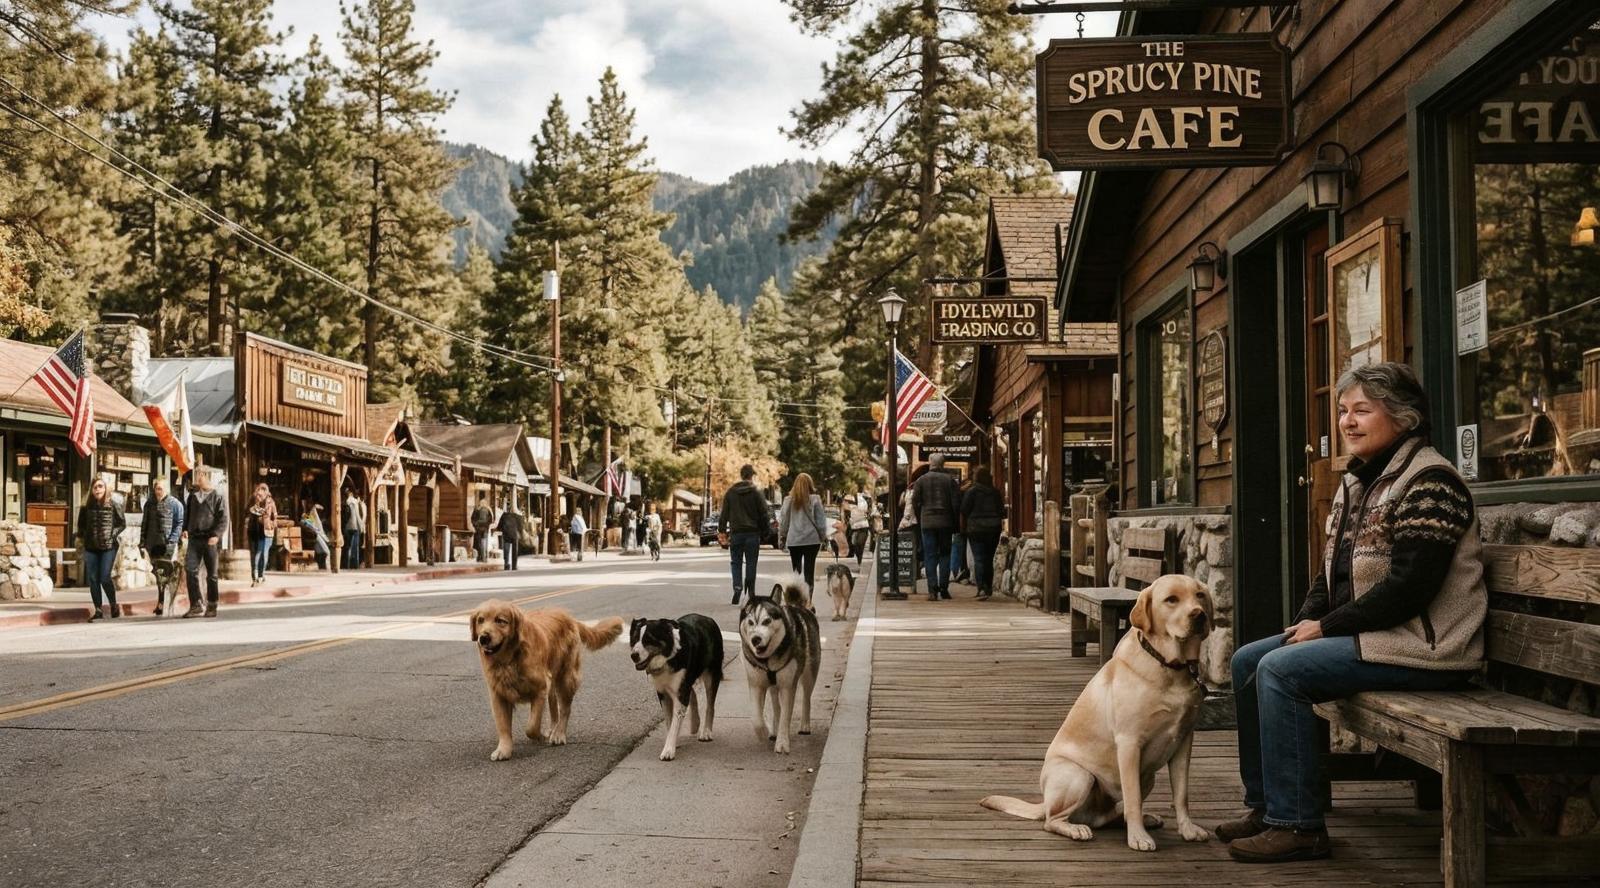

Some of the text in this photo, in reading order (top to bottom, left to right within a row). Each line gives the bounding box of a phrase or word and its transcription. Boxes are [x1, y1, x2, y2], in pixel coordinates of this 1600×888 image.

[1141, 41, 1184, 57] THE
[1068, 62, 1262, 104] SPRUCY PINE
[1087, 106, 1243, 151] CAFE
